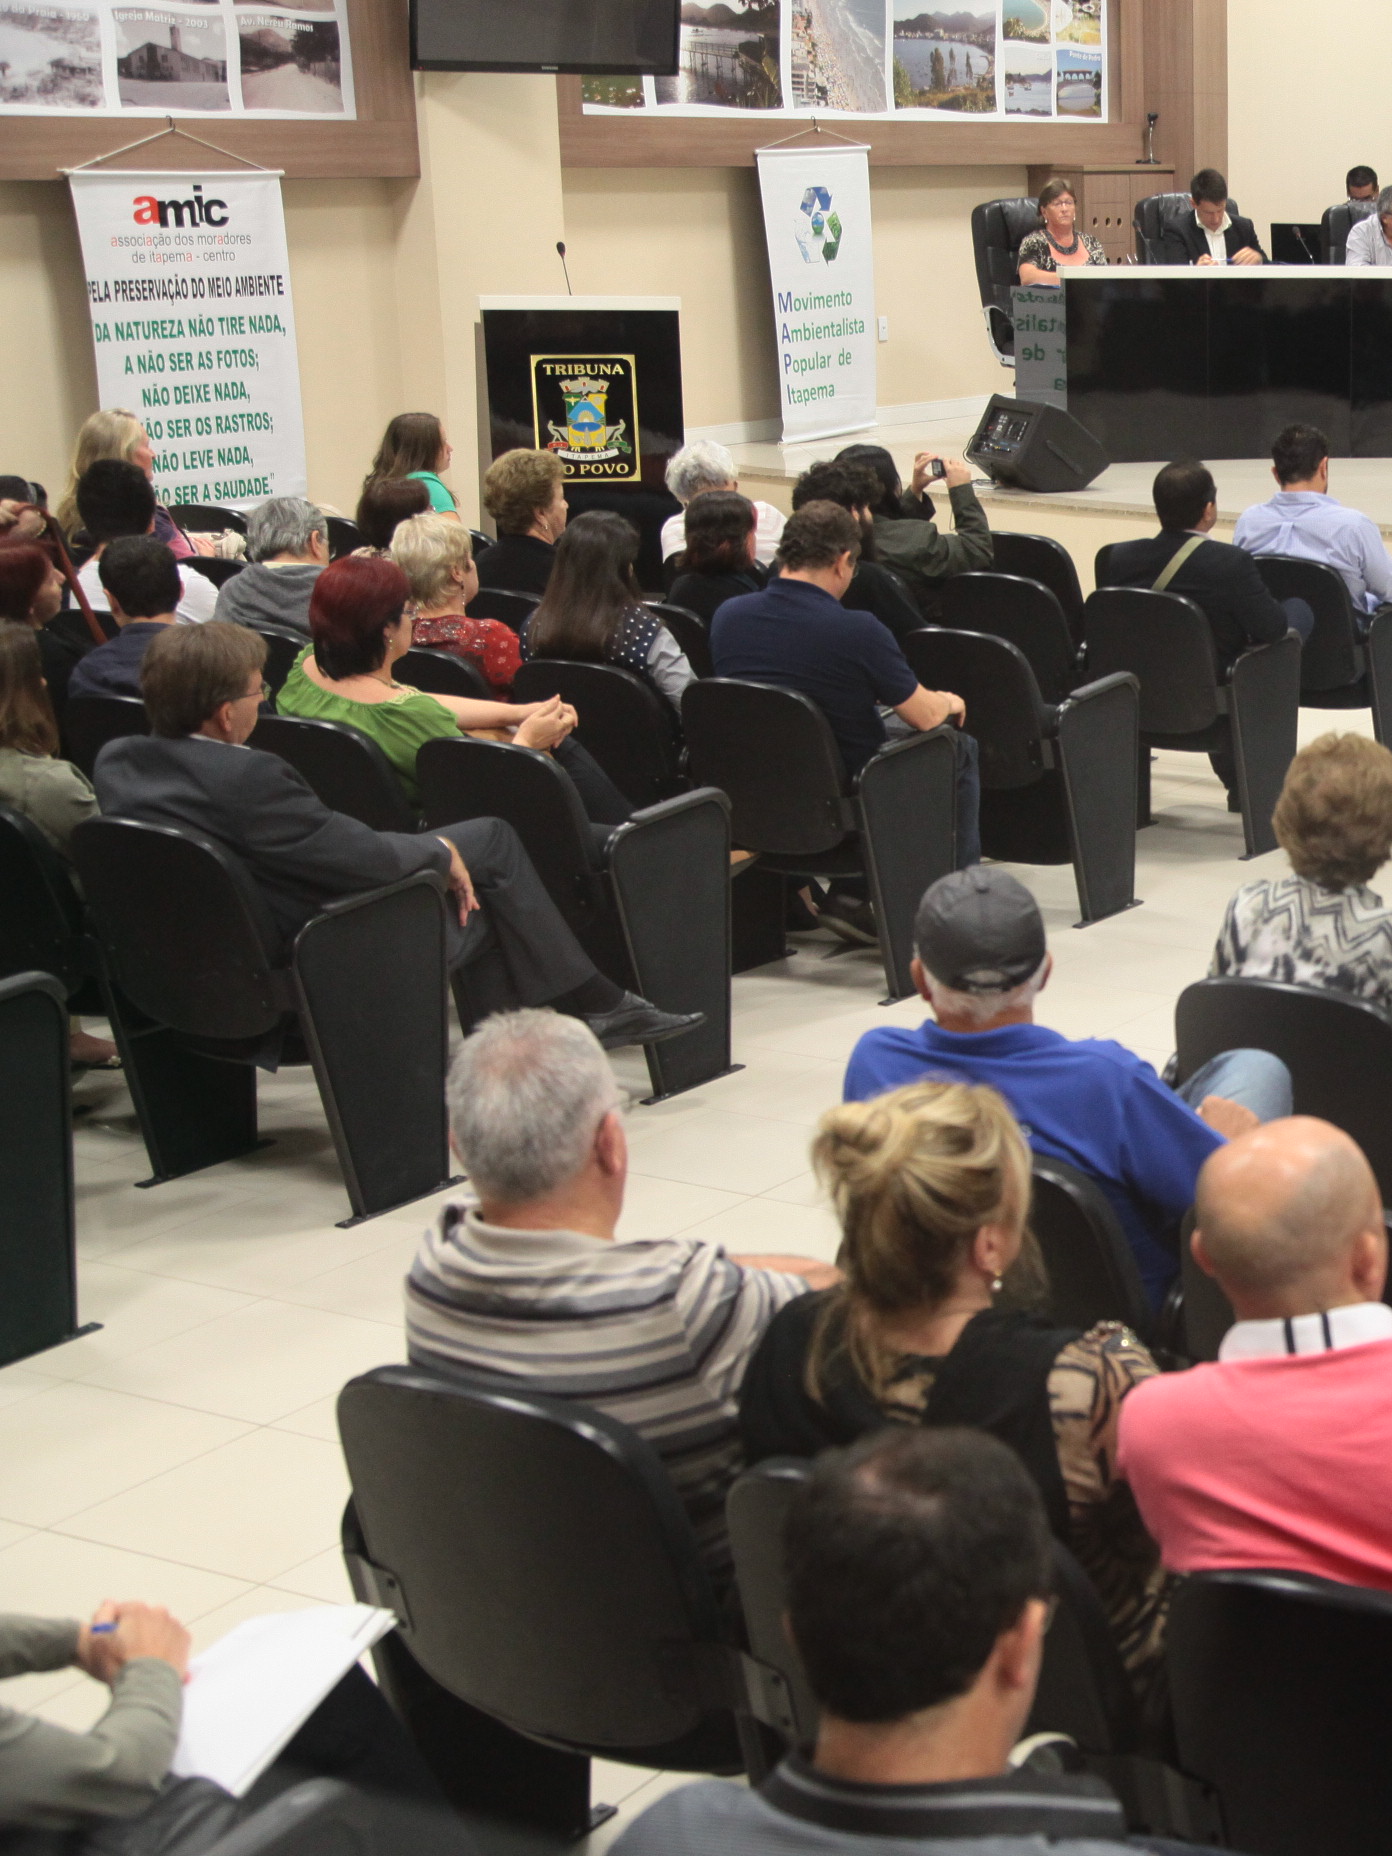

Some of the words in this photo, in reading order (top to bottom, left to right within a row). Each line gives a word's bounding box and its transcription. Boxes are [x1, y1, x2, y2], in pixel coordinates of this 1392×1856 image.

[114, 10, 143, 23] Igreja
[145, 11, 176, 25] Matriz
[185, 18, 208, 29] 2003
[241, 16, 255, 26] Av.
[285, 18, 314, 33] Ramos
[132, 184, 230, 229] amic
[111, 234, 172, 249] associação
[174, 233, 195, 246] dos
[197, 231, 252, 246] moradores
[132, 250, 146, 264] de
[149, 250, 193, 266] itapema
[203, 249, 236, 262] centro
[114, 273, 189, 306] PRESERVAÇÃO
[191, 277, 206, 299] DO
[208, 276, 232, 299] MEIO
[235, 274, 285, 298] AMBIENTE
[778, 290, 853, 314] Movimento
[94, 322, 112, 343] DA
[115, 319, 185, 342] NATUREZA
[188, 314, 215, 338] NÃO
[218, 316, 246, 336] TIRE
[249, 314, 286, 337] NADA,
[781, 317, 865, 345] Ambientalista
[124, 355, 134, 375] A
[137, 350, 165, 374] NÃO
[169, 351, 195, 372] SER
[198, 350, 213, 371] AS
[217, 348, 259, 372] FOTOS;
[543, 364, 624, 376] TRIBUNA
[783, 350, 831, 376] Popular
[838, 348, 852, 367] de
[141, 382, 170, 408] NÃO
[173, 384, 211, 405] DEIXE
[214, 380, 251, 404] NADA,
[786, 382, 835, 407] Itapema
[141, 418, 163, 440] ÃO
[167, 419, 192, 439] SER
[195, 416, 212, 436] OS
[215, 411, 273, 434] RASTROS;
[152, 449, 179, 473] NÃO
[183, 449, 214, 470] LEVE
[218, 446, 254, 468] NADA,
[566, 452, 609, 460] ITAPEMA
[580, 463, 630, 475] POVO
[154, 485, 171, 507] ÃO
[174, 484, 200, 506] SER
[202, 483, 212, 502] A
